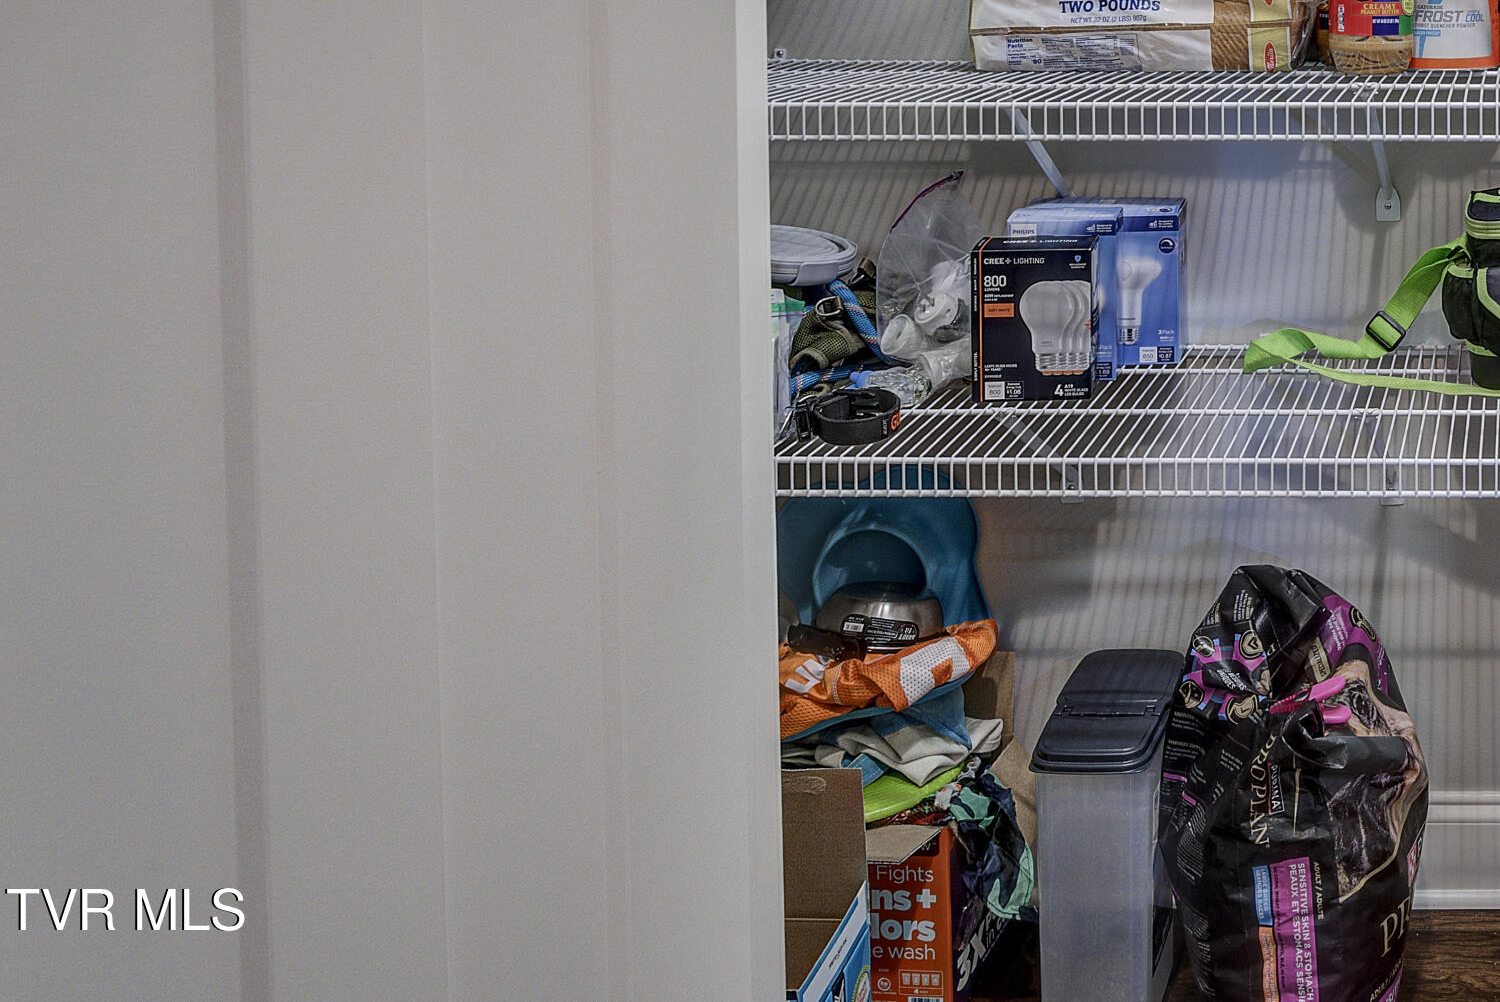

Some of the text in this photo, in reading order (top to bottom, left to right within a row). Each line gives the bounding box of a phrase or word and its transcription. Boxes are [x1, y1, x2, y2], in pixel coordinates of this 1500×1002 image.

[1059, 0, 1094, 14] TWO
[1415, 10, 1464, 23] FROST
[983, 275, 1007, 287] 800
[1054, 384, 1064, 397] 4
[1250, 730, 1277, 845] PRO PLAN
[1271, 764, 1281, 810] PURINA
[876, 865, 935, 884] Fights
[1289, 864, 1299, 897] PEAUX
[1313, 861, 1322, 885] ADULT
[1297, 863, 1309, 914] SENSITIVE
[1291, 901, 1300, 914] ET
[1315, 892, 1325, 920] ADULTE
[1301, 915, 1311, 941] SKIN
[888, 944, 936, 960] wash
[1293, 915, 1304, 968] ESTOMACS
[956, 918, 987, 992] 3X
[1304, 952, 1315, 1001] STOMACH
